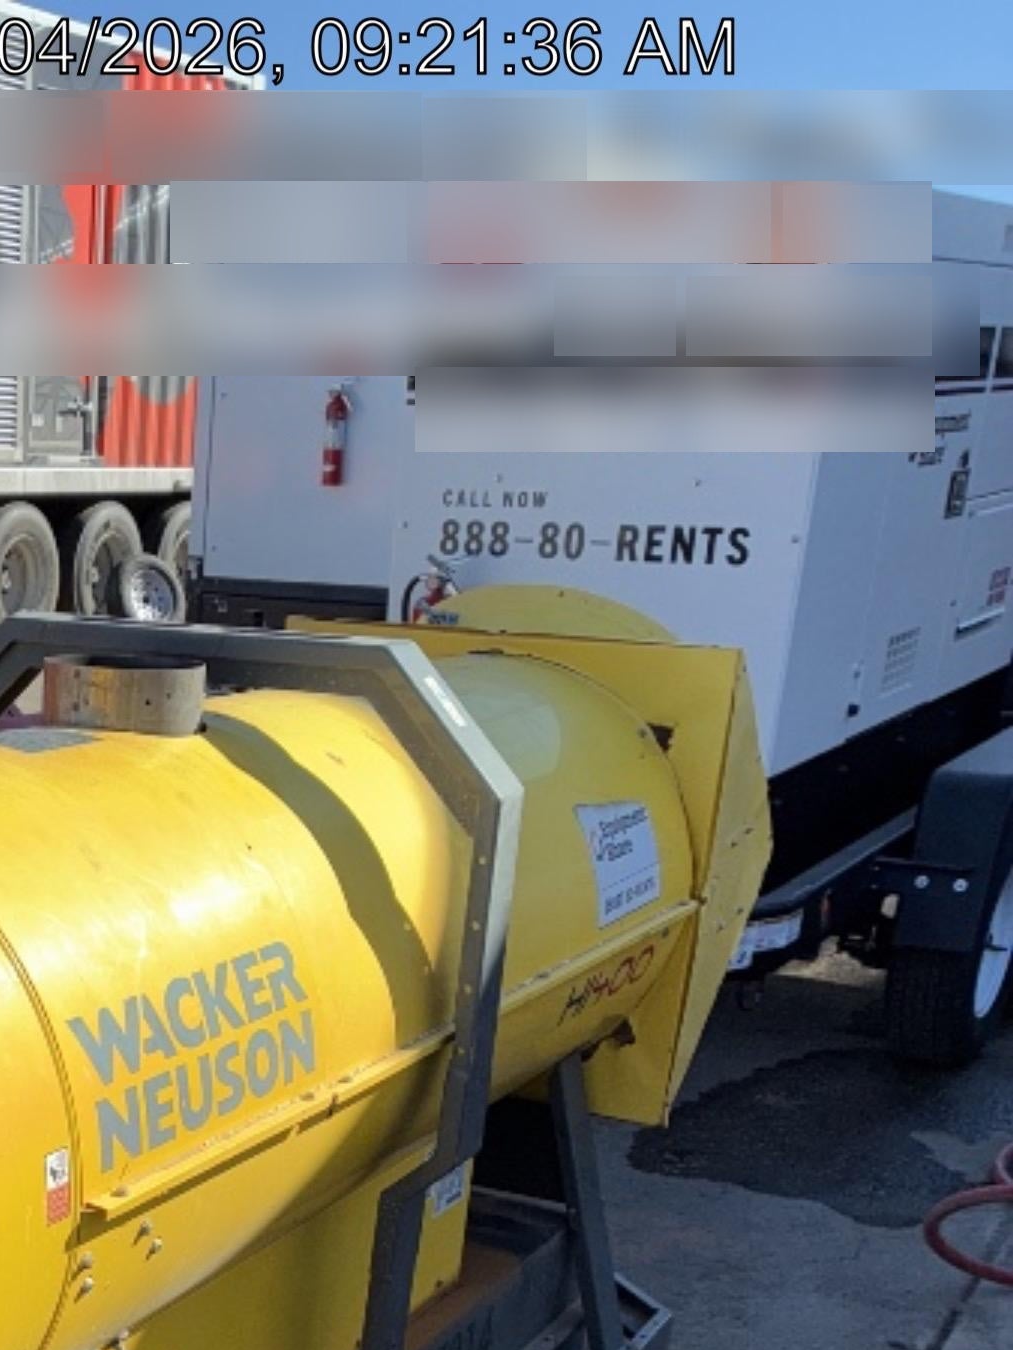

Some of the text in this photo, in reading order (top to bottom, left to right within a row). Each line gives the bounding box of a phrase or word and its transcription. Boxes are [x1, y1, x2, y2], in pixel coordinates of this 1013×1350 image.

[439, 518, 751, 567] 888-80-RENTS
[442, 489, 549, 509] CALL NOW
[66, 941, 309, 1087] WACKER
[95, 1009, 317, 1175] NEUSON
